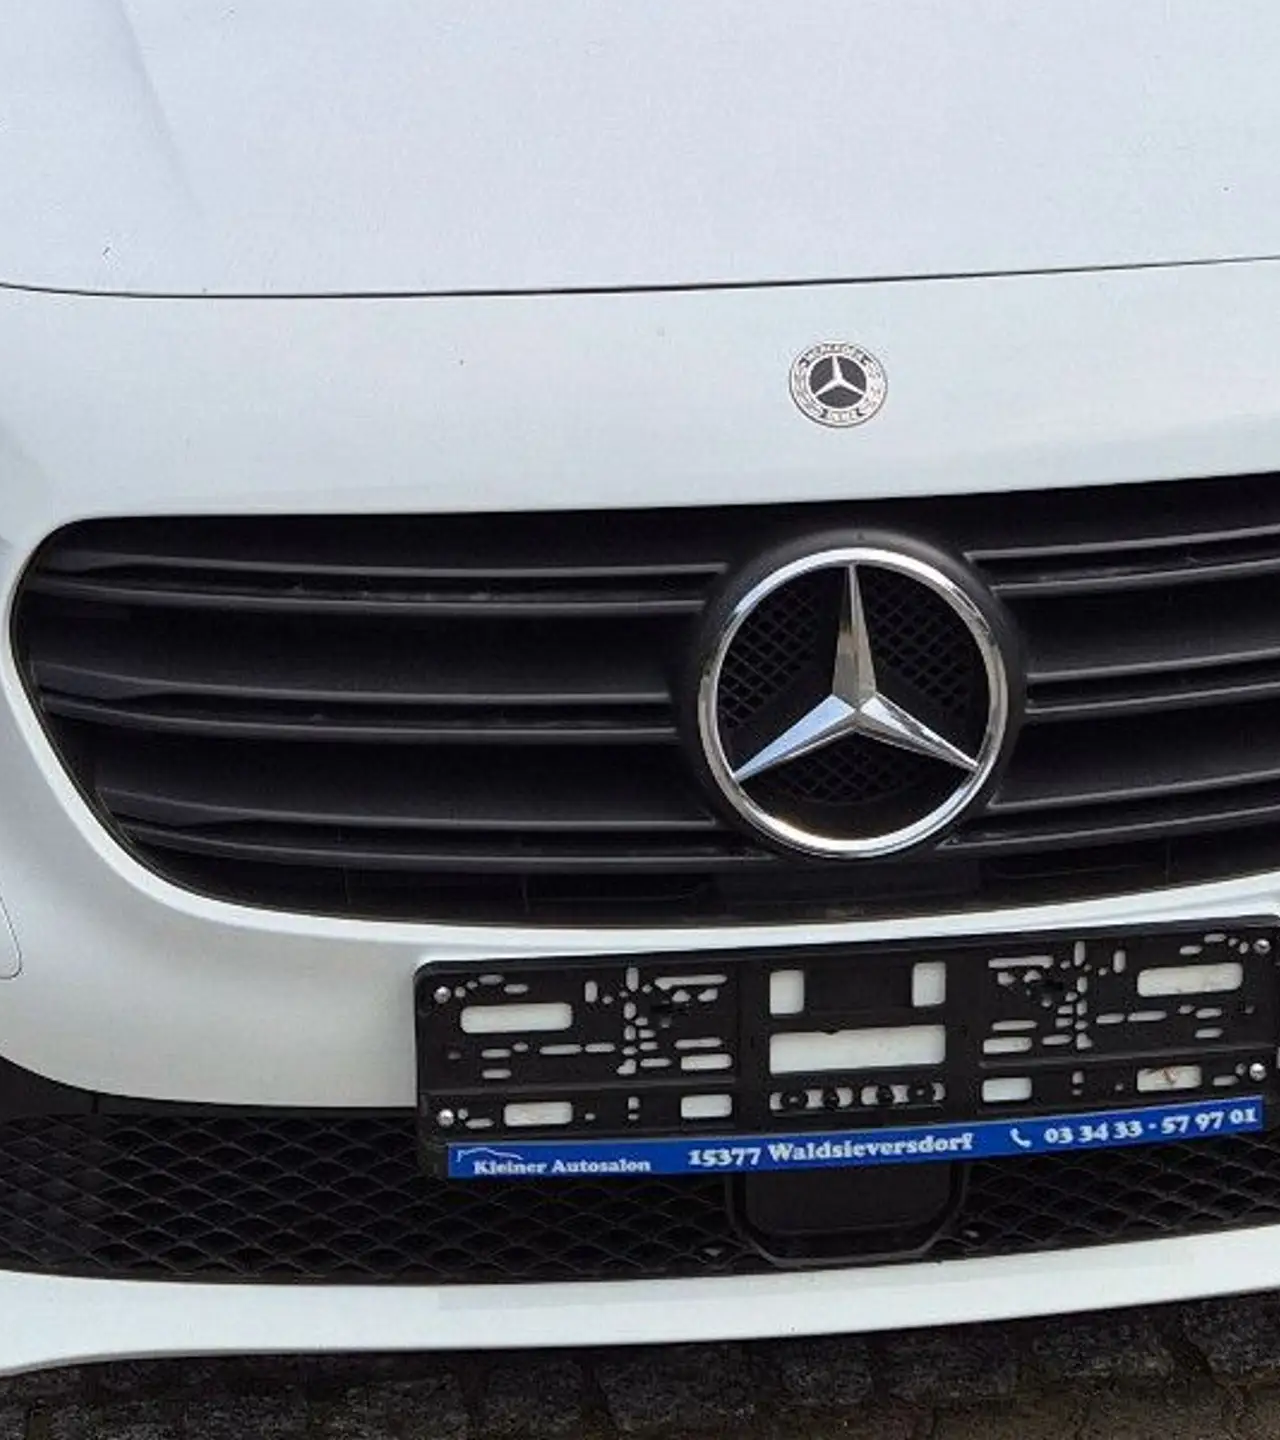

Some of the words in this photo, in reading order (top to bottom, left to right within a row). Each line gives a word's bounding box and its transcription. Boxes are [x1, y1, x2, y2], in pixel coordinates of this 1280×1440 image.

[1043, 1126, 1073, 1144] 03
[1078, 1122, 1109, 1142] 34
[1113, 1120, 1143, 1140] 33
[1161, 1115, 1190, 1135] 57
[1195, 1111, 1225, 1132] 97
[688, 1147, 761, 1167] 15377
[767, 1131, 974, 1162] Waldsieversdorf
[474, 1160, 548, 1175] Kleiner
[551, 1158, 652, 1174] Autosalon
